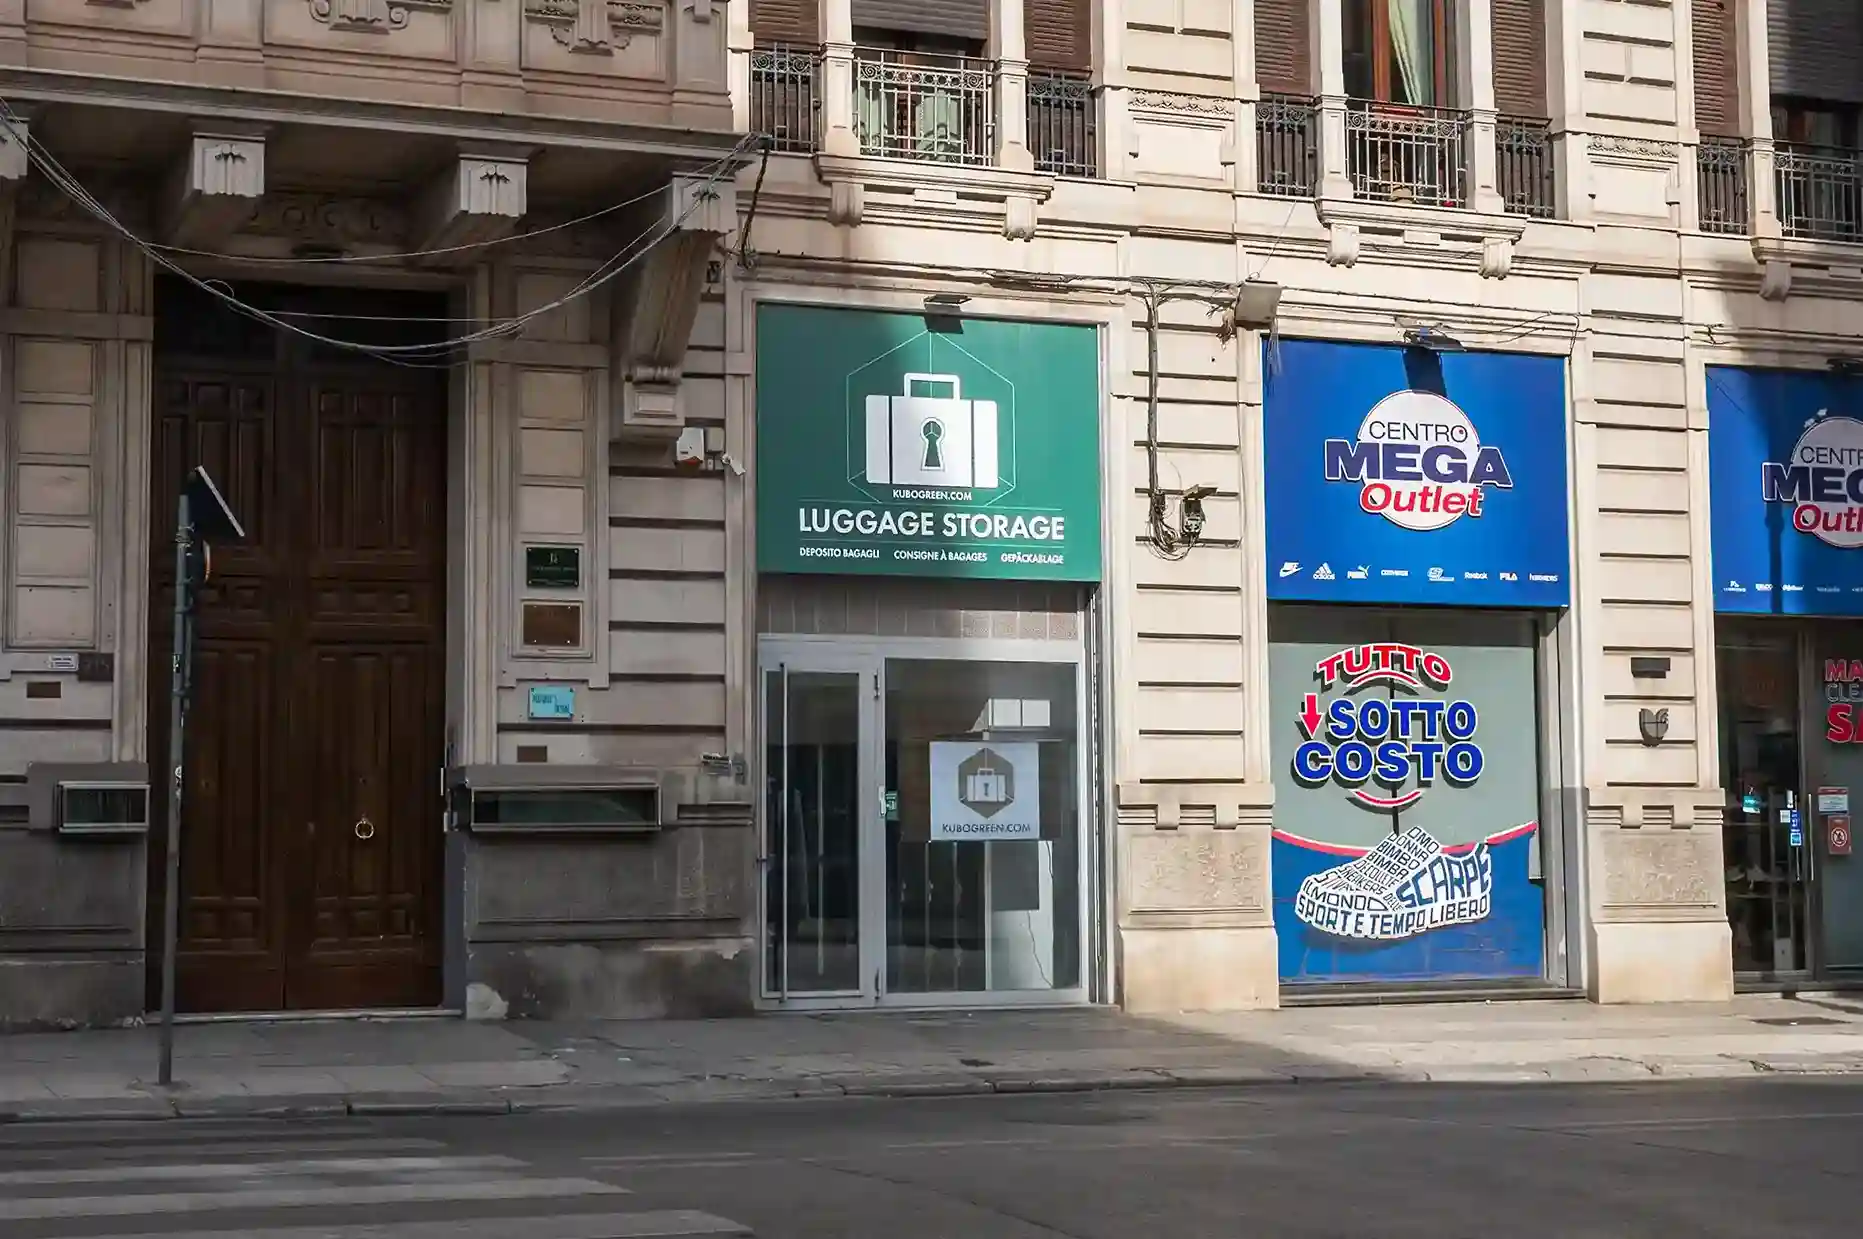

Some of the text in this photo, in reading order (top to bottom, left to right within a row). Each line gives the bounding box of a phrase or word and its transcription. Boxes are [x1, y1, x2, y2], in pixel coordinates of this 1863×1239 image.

[1369, 420, 1468, 443] CENTRO
[1325, 439, 1513, 488] MEGA
[892, 489, 972, 501] KUBOGREEN.COM
[1361, 482, 1483, 516] Outlet
[799, 507, 1065, 541] LUGGAGE STORAGE
[799, 546, 841, 558] DEPOSITO
[843, 548, 880, 559] BAGAGLI
[893, 549, 939, 561] CONSIGNE
[948, 551, 988, 562] BAGAGES
[1316, 643, 1453, 684] TUTTO
[1328, 698, 1478, 740] SOTTO
[1294, 740, 1485, 782] COSTO
[942, 823, 1031, 834] KUBOGREEN.COM
[1366, 850, 1410, 880] BIMBA
[1376, 840, 1421, 871] BIMBO
[1395, 843, 1491, 909] SCARPE
[1298, 895, 1353, 933] SPORT
[1369, 909, 1426, 935] TEMPO
[1429, 895, 1488, 924] LIBERO
